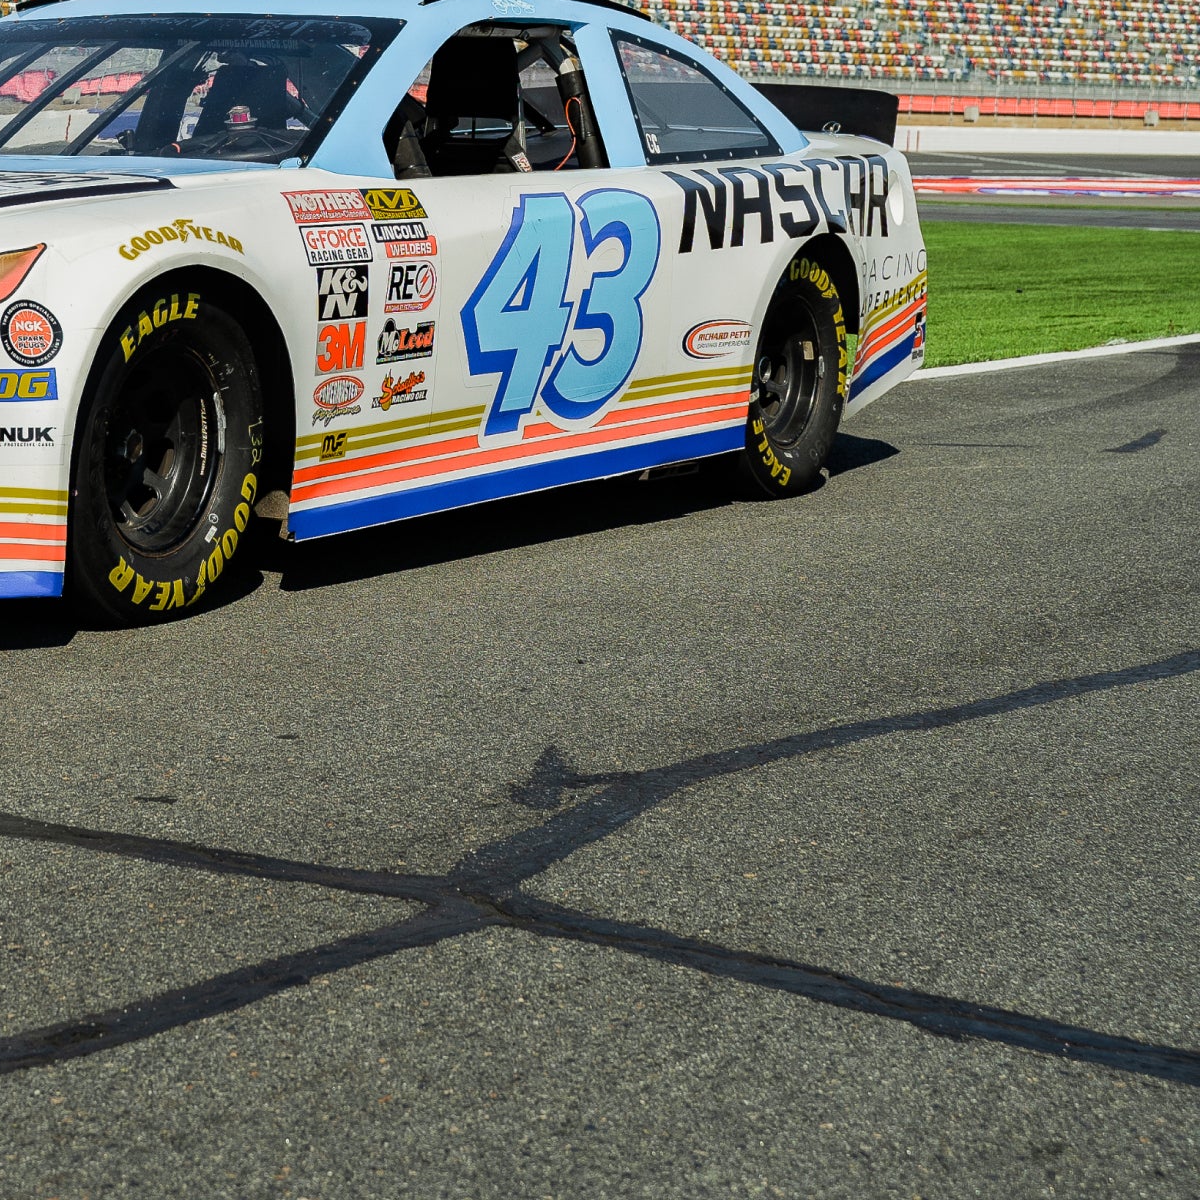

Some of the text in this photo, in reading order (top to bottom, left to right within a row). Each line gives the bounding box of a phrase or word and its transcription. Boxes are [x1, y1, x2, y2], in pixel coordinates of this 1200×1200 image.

[285, 191, 366, 212] MOTHERS
[661, 154, 889, 254] NASCAR
[373, 223, 425, 241] LINCOLN
[310, 247, 369, 263] RACING GEAR
[390, 241, 432, 256] WELDERS
[460, 188, 661, 437] 43
[15, 320, 44, 332] NGK
[120, 293, 201, 364] EAGLE
[18, 341, 46, 349] PLUGS
[698, 331, 751, 341] RICHARD PETTY
[317, 321, 367, 373] 3M
[752, 416, 792, 486] EAGLE
